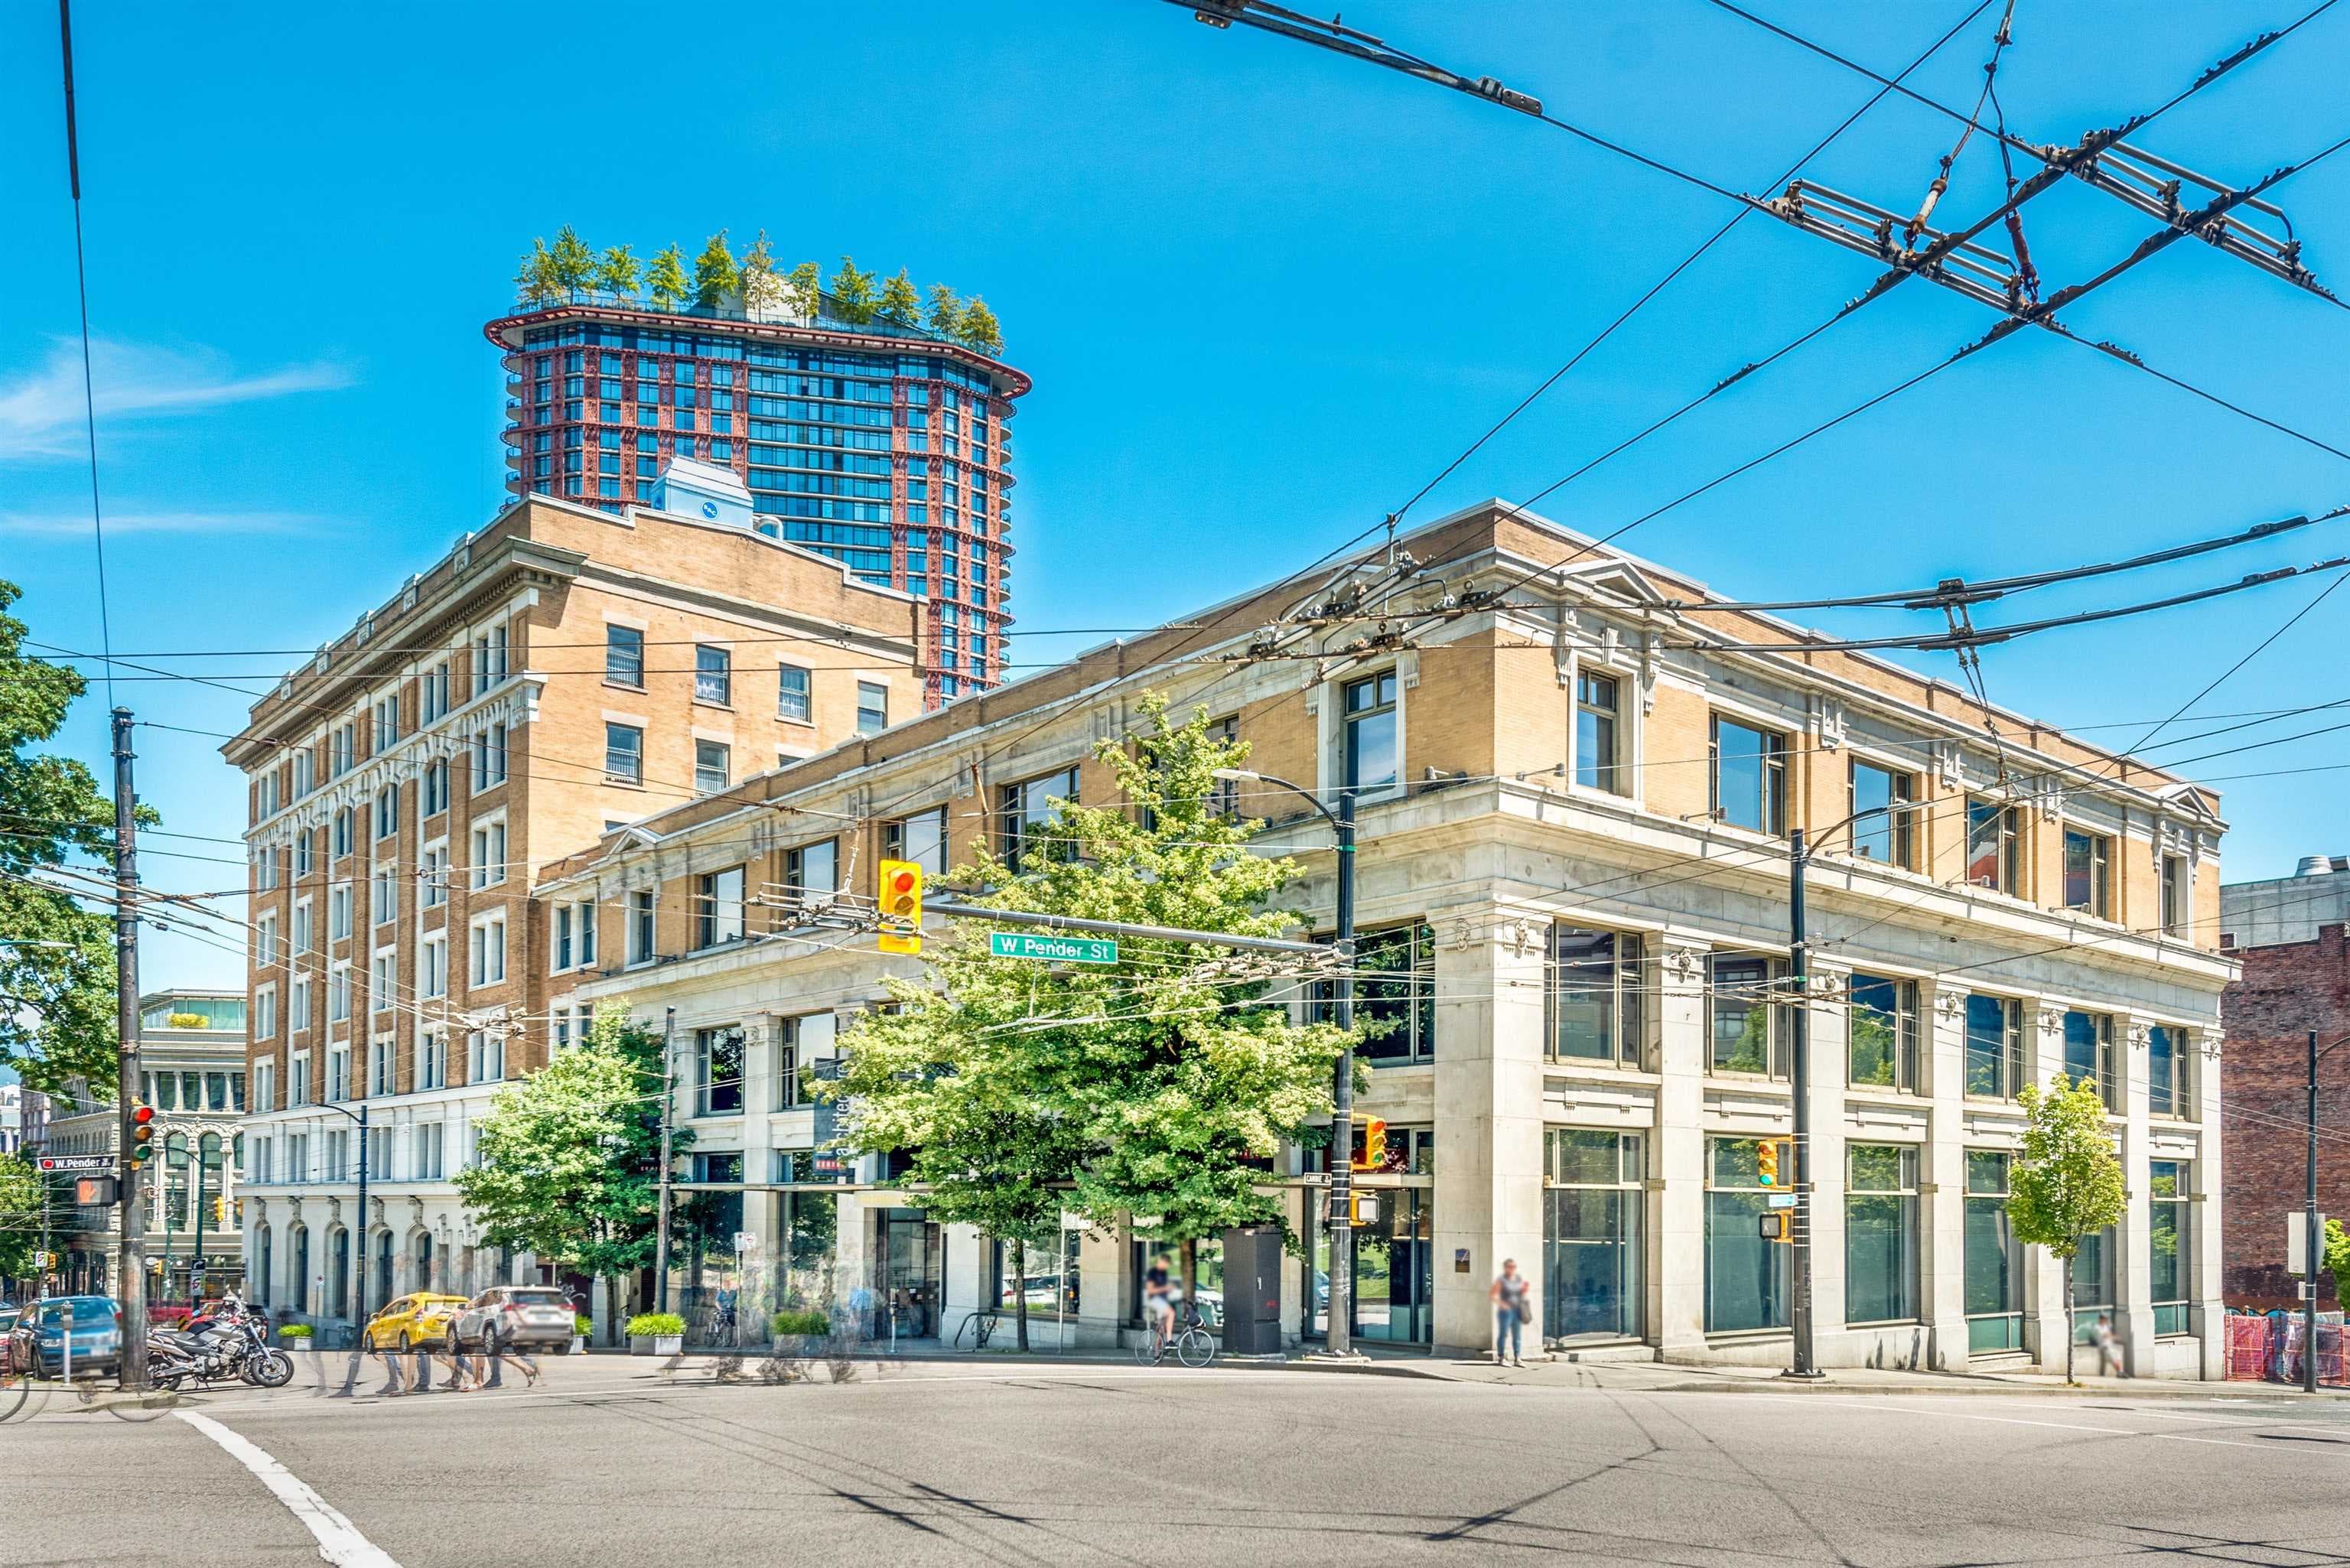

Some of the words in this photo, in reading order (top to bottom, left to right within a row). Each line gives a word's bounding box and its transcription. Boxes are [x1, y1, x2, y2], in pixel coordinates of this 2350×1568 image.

[1001, 937, 1017, 952] W
[1025, 939, 1083, 957] Pender
[1091, 944, 1108, 958] St
